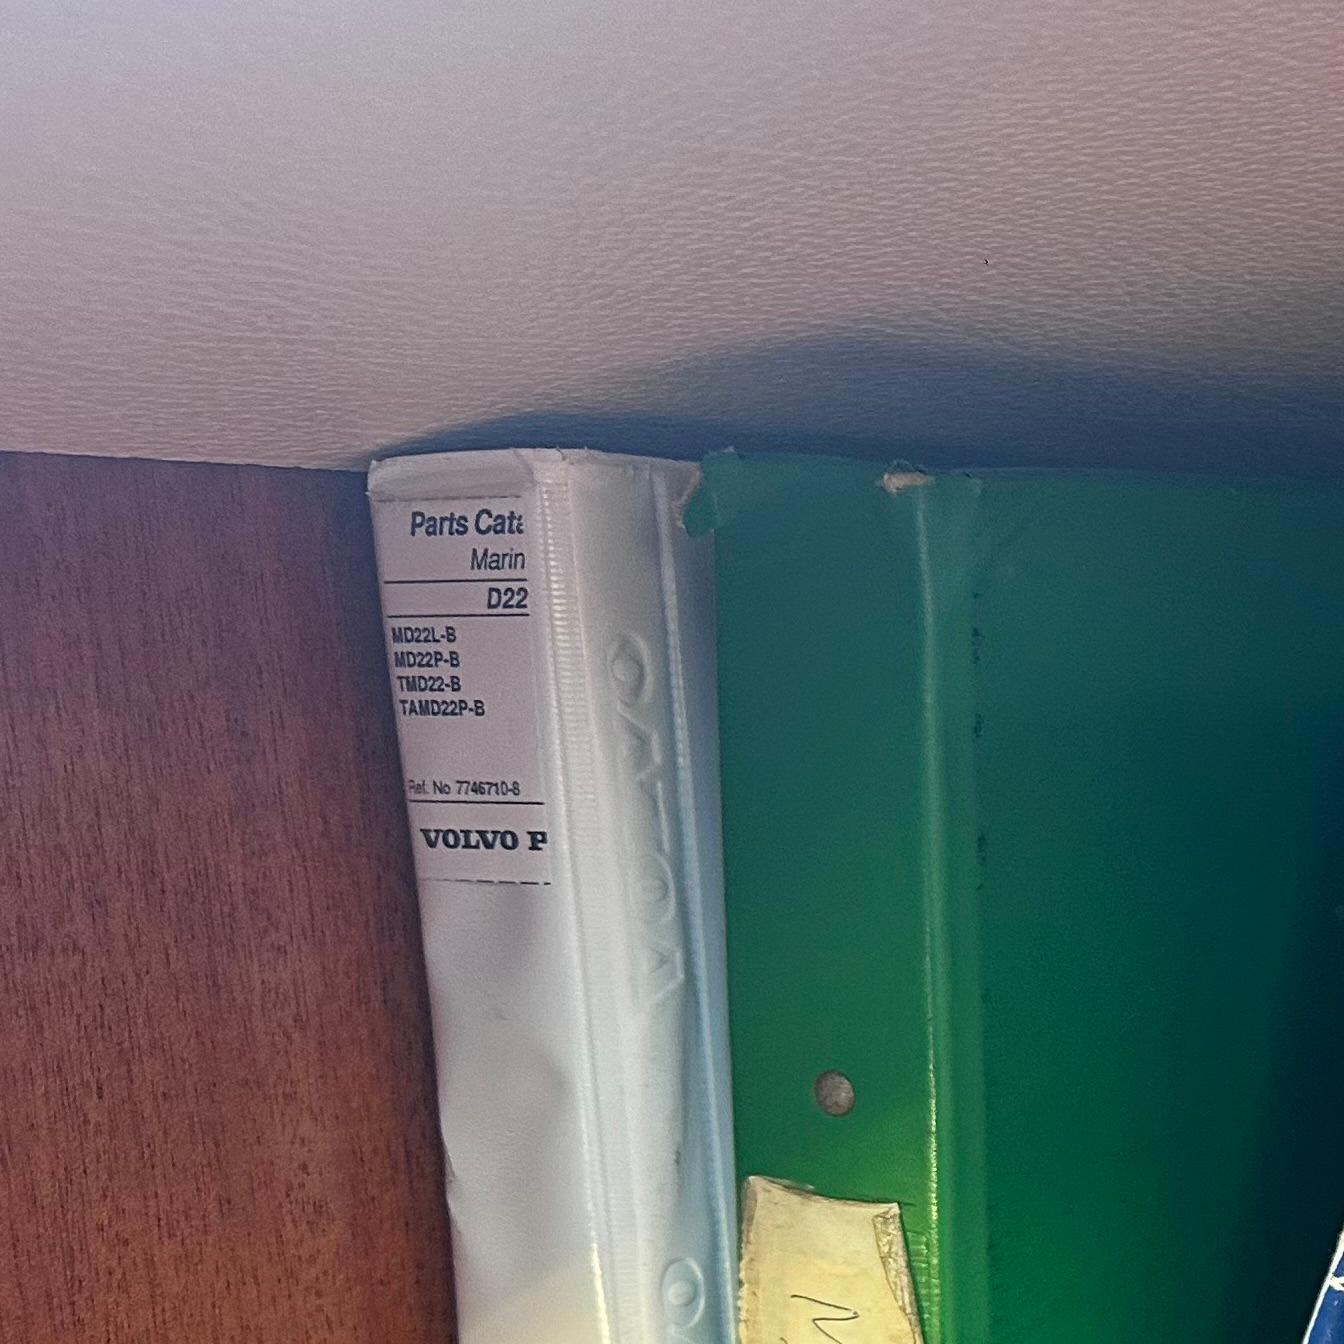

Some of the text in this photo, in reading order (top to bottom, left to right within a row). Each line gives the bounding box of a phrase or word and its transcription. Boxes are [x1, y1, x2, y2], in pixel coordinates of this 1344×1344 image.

[410, 509, 469, 537] Parts
[470, 547, 526, 571] Marin
[486, 587, 529, 610] D22
[391, 625, 457, 644] MD22L-B
[394, 650, 461, 669] MD22P-B
[396, 675, 462, 693] TMD22-B
[399, 699, 486, 717] TAMD22P-B
[433, 779, 451, 796] No
[419, 828, 520, 851] VOLVO
